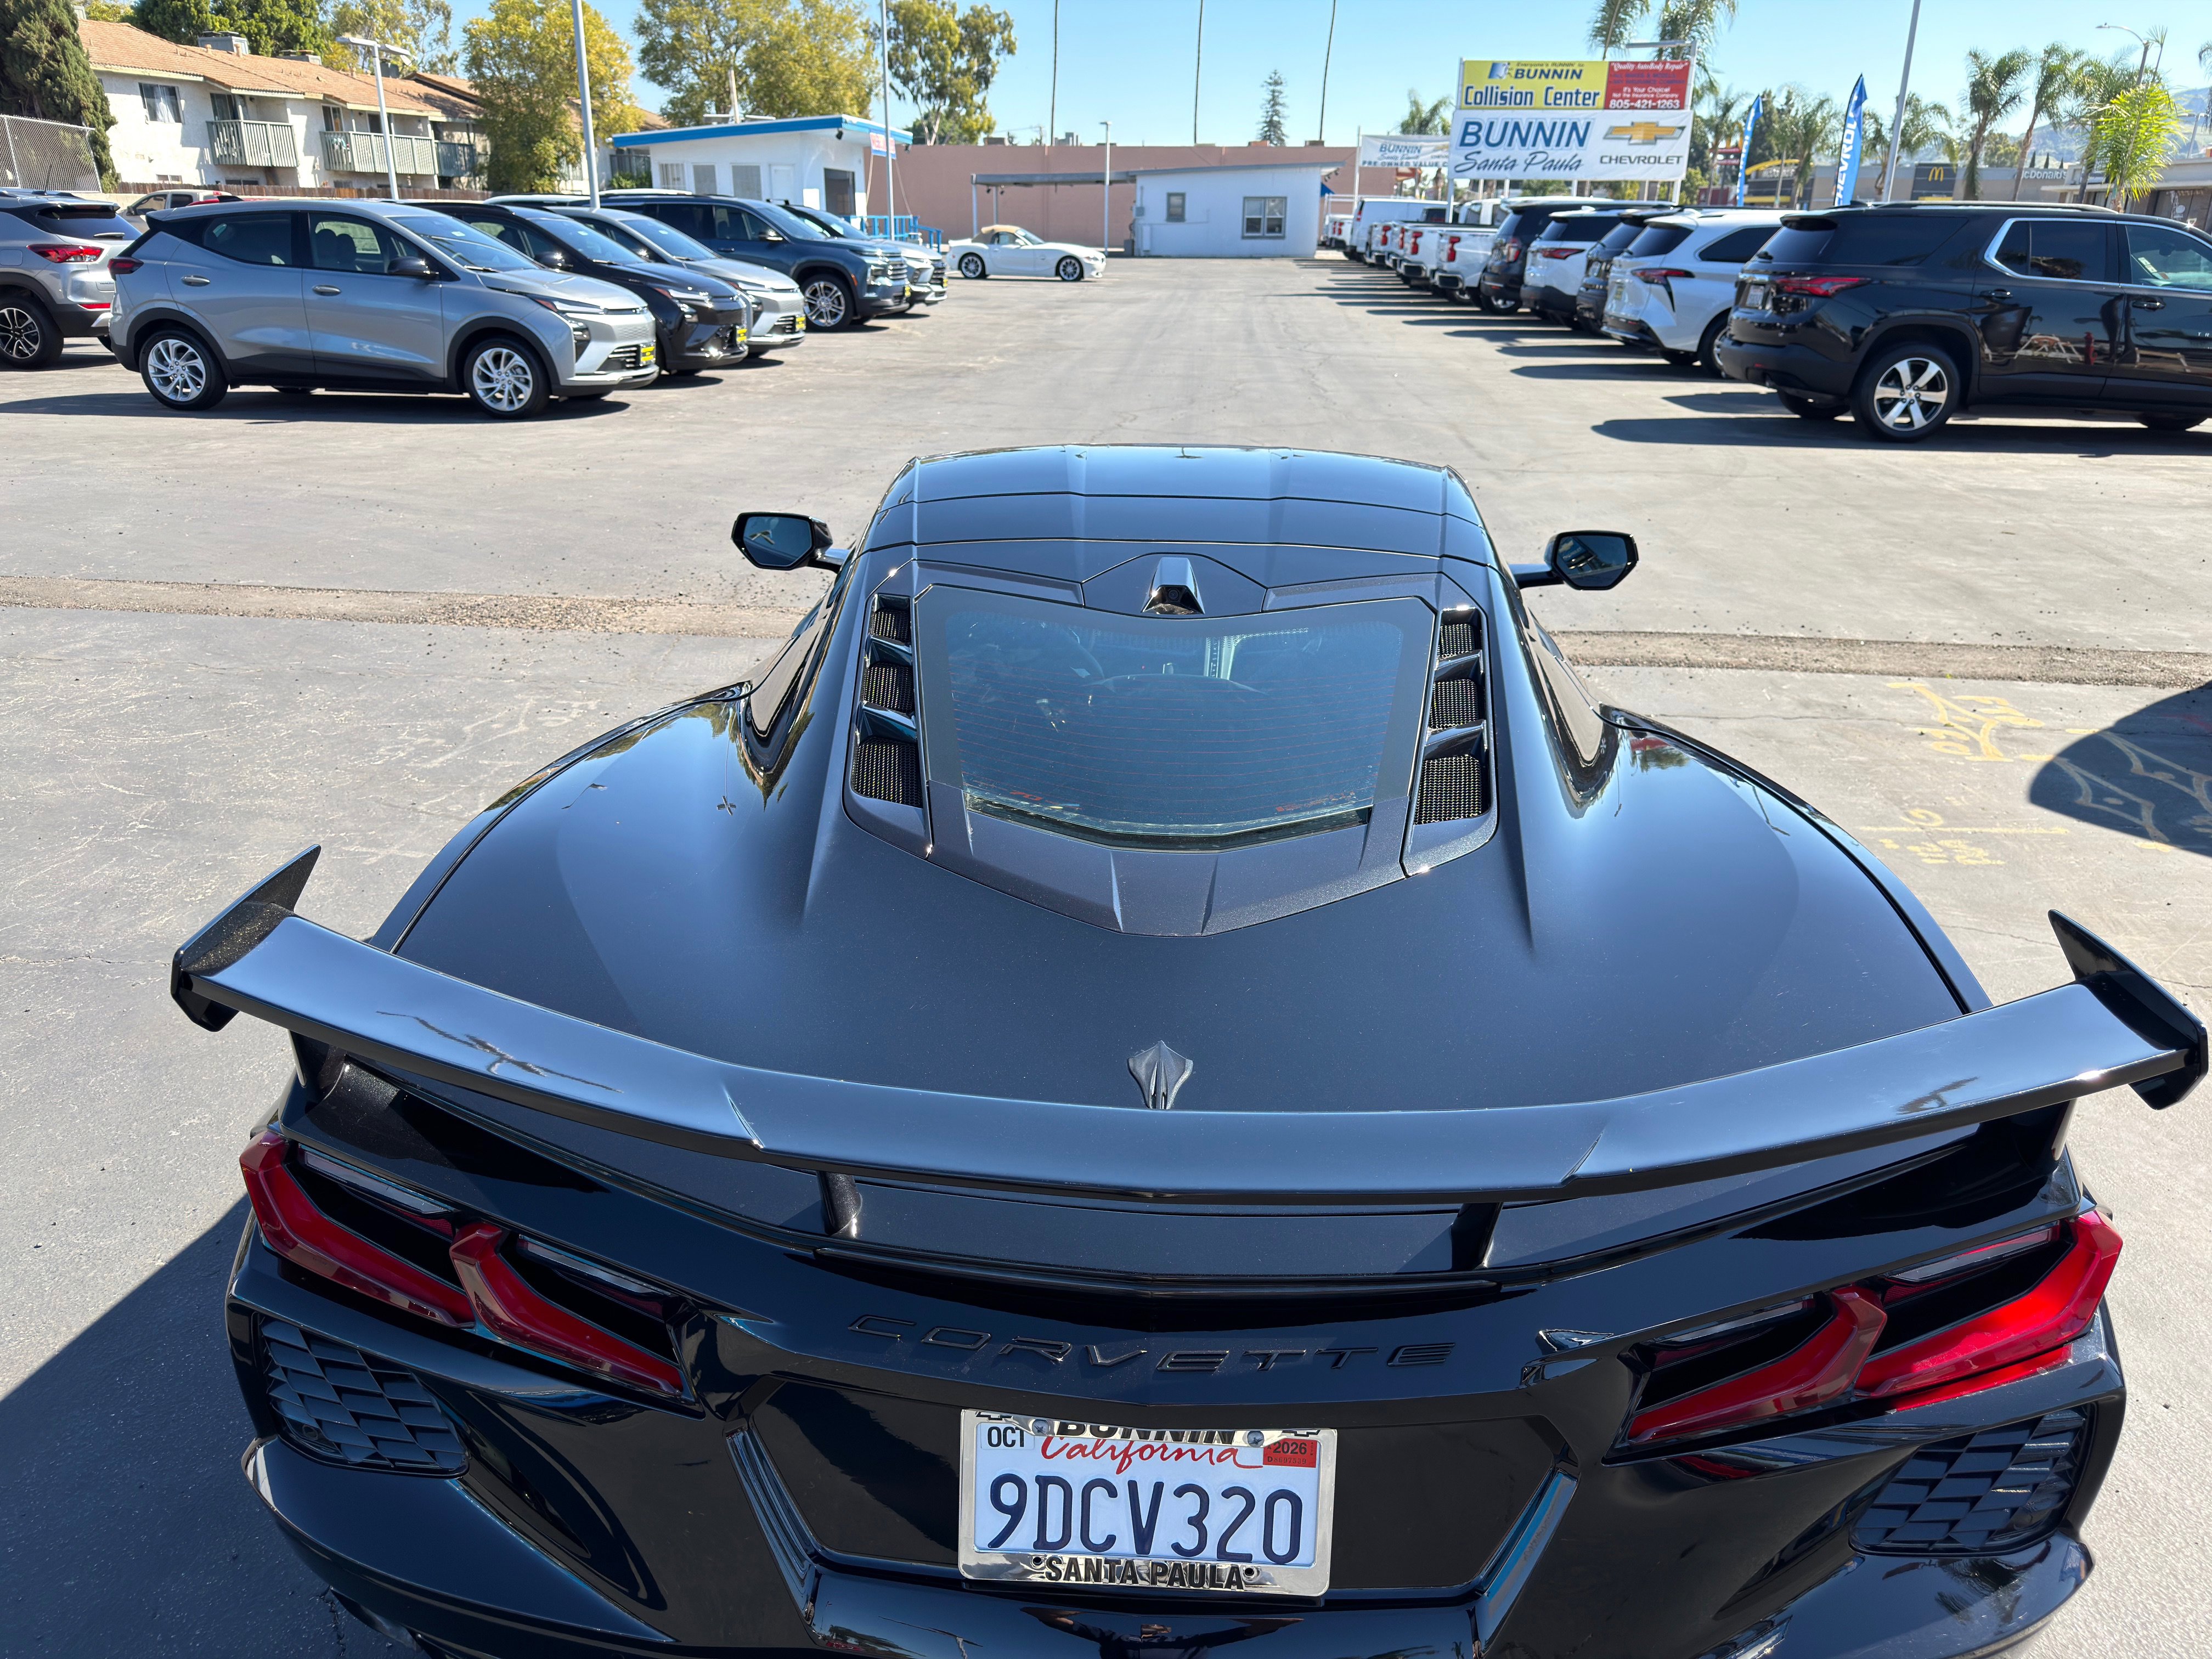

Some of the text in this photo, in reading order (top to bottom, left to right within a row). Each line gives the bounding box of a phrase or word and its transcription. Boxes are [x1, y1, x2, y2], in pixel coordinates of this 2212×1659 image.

[1514, 69, 1583, 79] BUNNIN
[1464, 86, 1600, 106] Collision Center
[1609, 99, 1680, 109] 805-421-1263
[1457, 119, 1593, 149] BUNNIN
[1379, 143, 1422, 154] BUNNIN
[1454, 150, 1583, 173] Santa Paula
[1600, 155, 1683, 165] CHEVROLET
[2014, 168, 2067, 179] cDonald's
[848, 1314, 1455, 1372] CORVETTE
[987, 1426, 1024, 1448] OCT
[1041, 1436, 1263, 1475] California
[1273, 1441, 1307, 1455] 2026
[988, 1473, 1302, 1564] 9DCV320
[1045, 1556, 1244, 1590] SANTA PAULA
